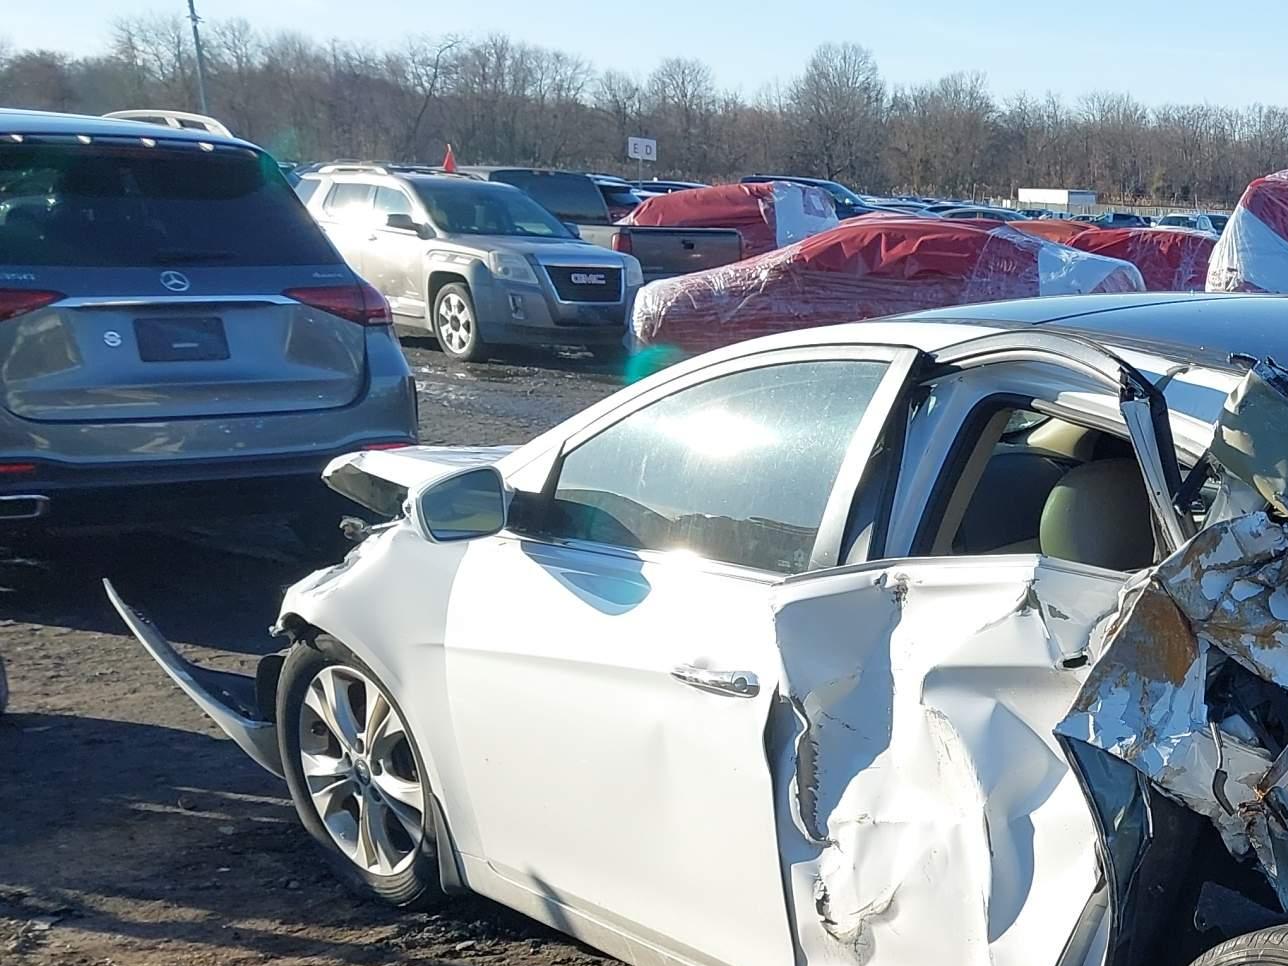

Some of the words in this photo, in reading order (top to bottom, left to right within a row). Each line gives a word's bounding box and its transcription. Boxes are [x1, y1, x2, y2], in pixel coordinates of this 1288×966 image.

[633, 143, 640, 154] E
[645, 144, 653, 156] D
[571, 273, 606, 284] GMC
